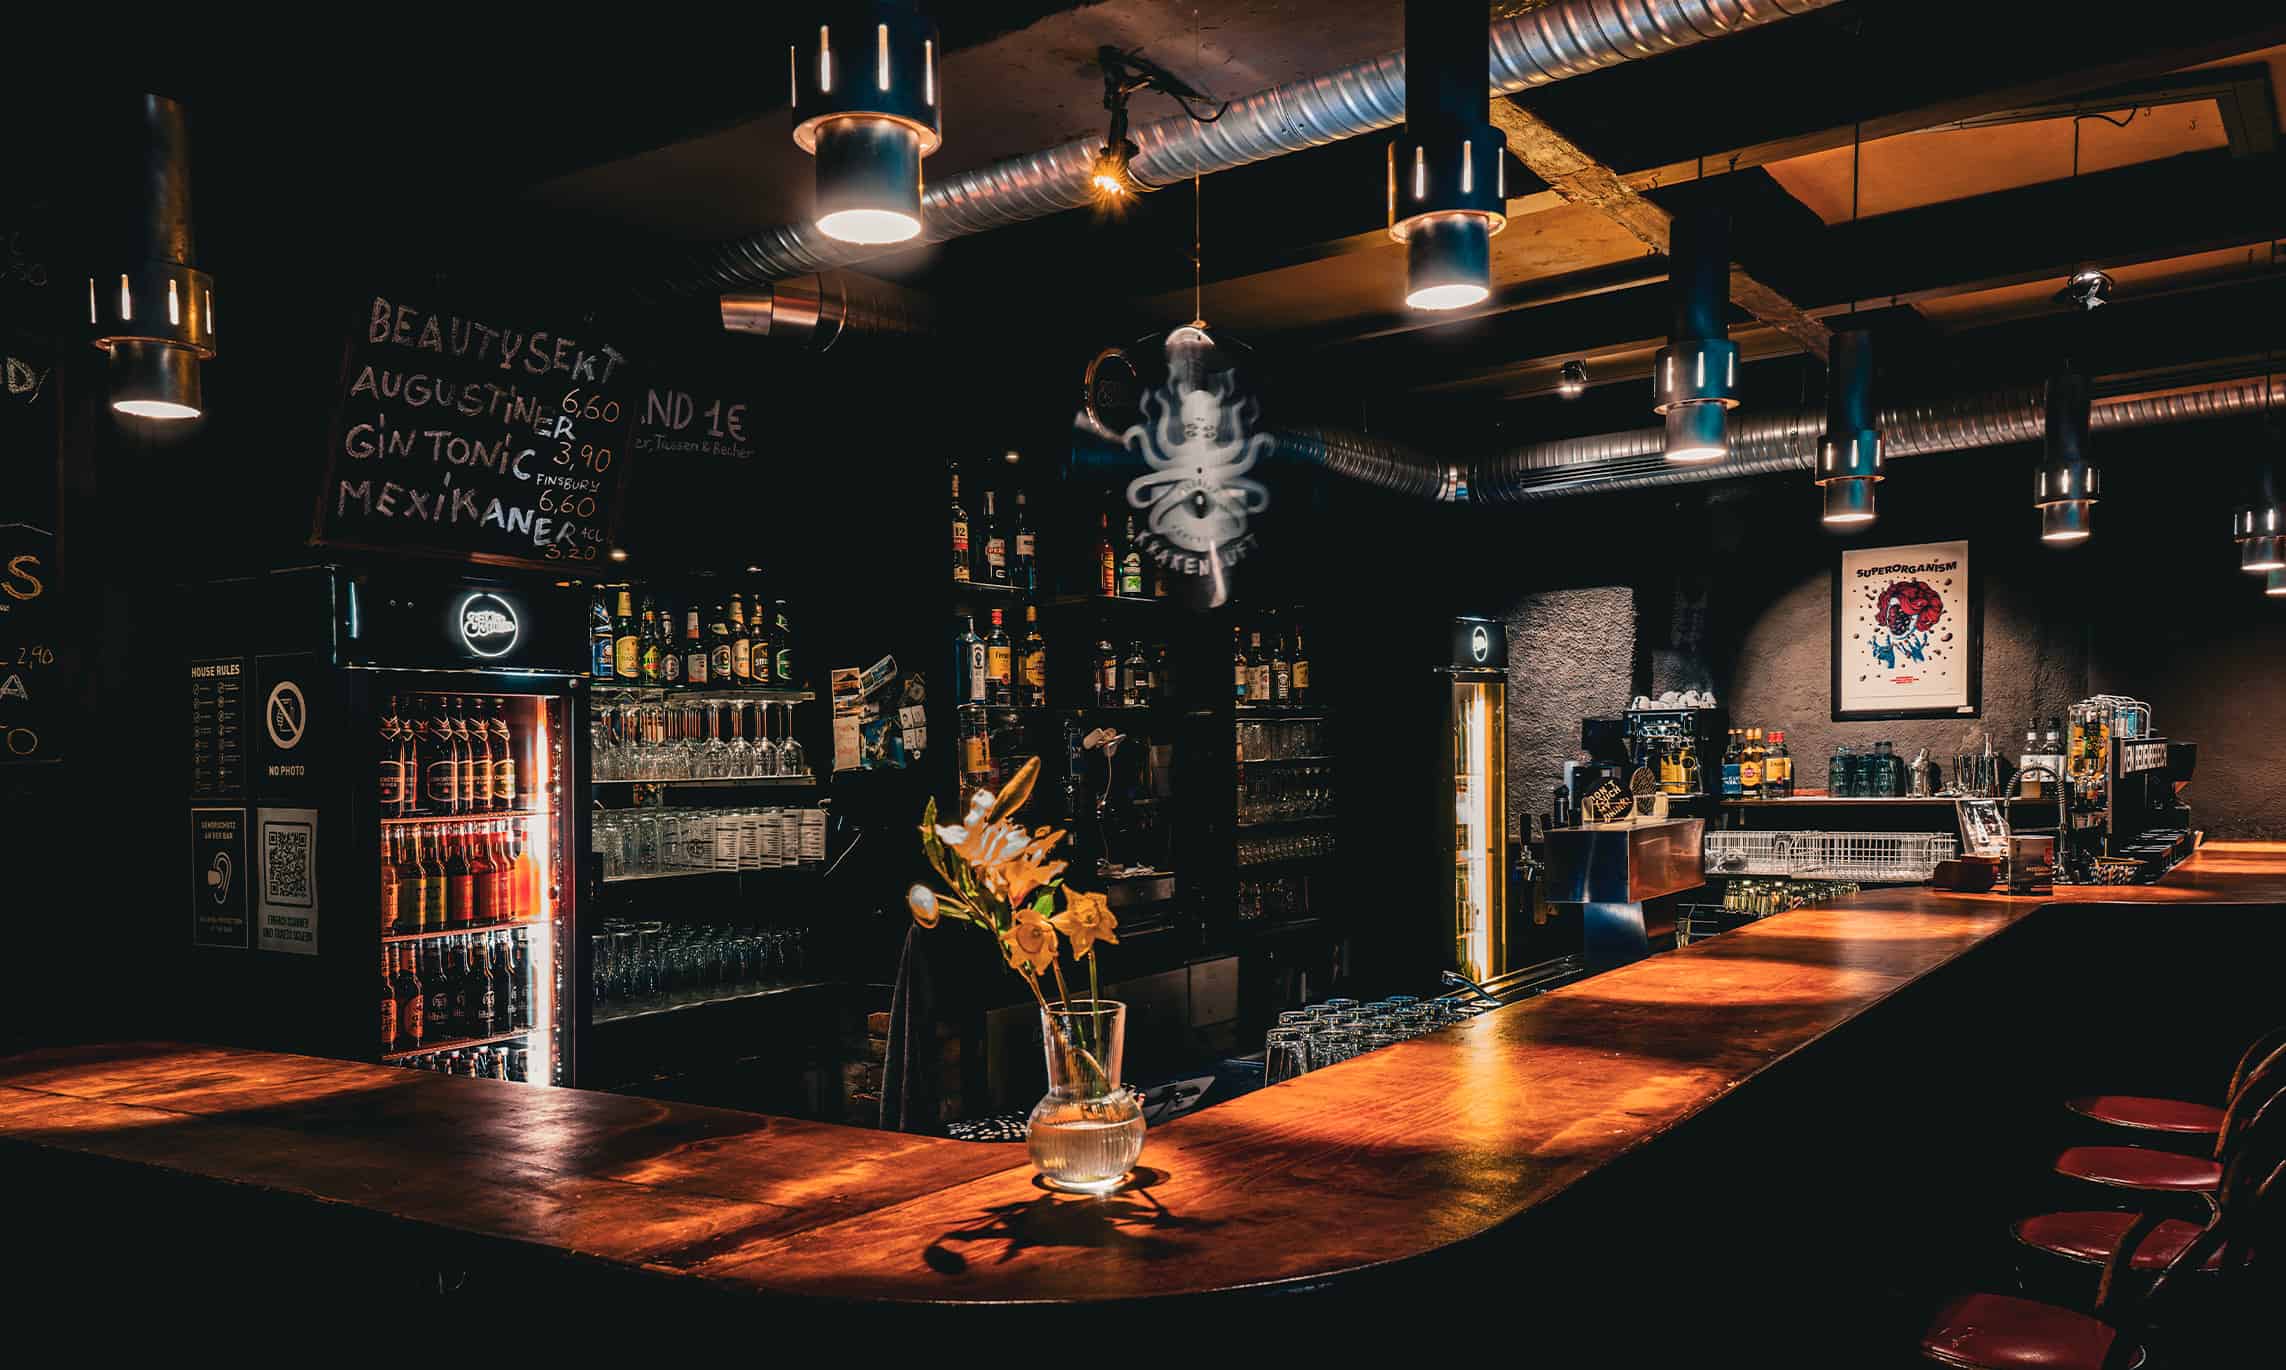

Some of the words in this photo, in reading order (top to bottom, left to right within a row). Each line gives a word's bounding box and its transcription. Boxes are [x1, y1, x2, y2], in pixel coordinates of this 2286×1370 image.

[561, 387, 622, 424] 6,60
[640, 387, 696, 431] ND
[704, 399, 747, 443] 1€
[552, 441, 613, 474] 3,90
[538, 488, 597, 518] 6,60
[1856, 561, 1958, 577] SUPERORGANISM
[191, 665, 215, 679] HOUSE
[216, 663, 240, 677] RULES
[267, 765, 280, 777] NO
[281, 765, 305, 777] PHOTO
